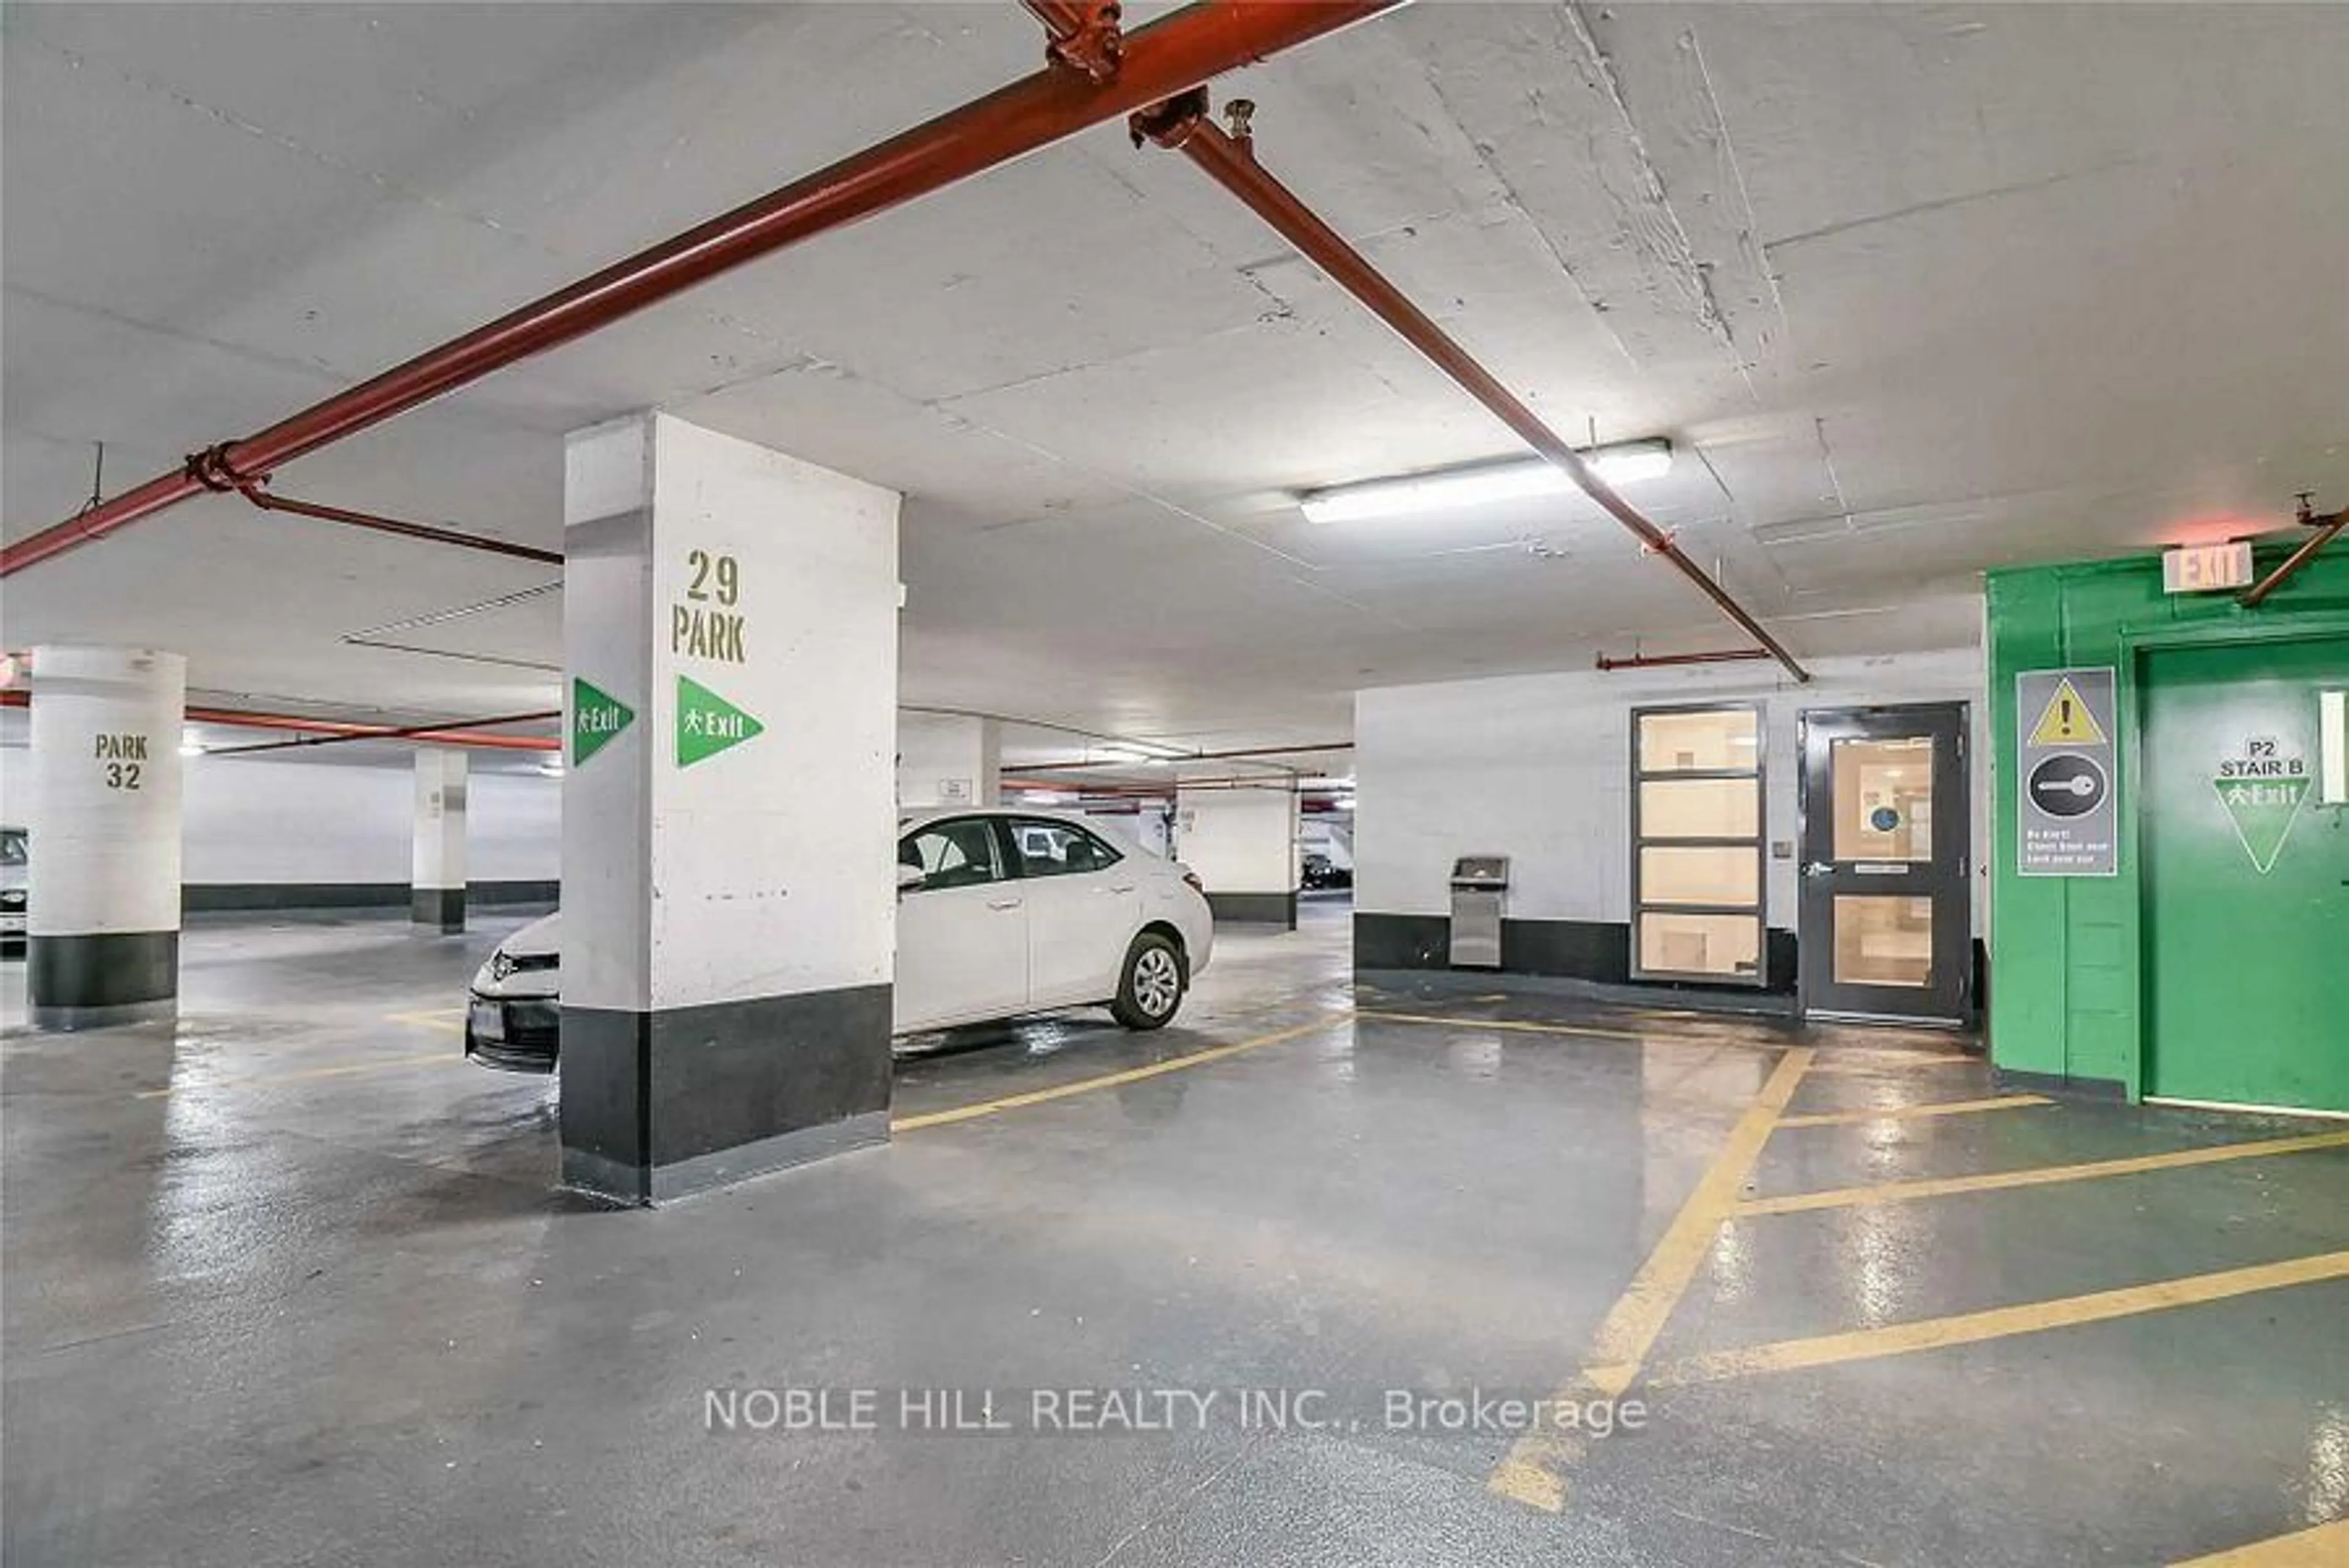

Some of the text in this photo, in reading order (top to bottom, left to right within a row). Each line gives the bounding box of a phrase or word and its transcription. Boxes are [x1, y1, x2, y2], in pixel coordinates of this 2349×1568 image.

[688, 549, 738, 606] 29
[2180, 548, 2238, 585] EXIT
[672, 604, 744, 663] PARK
[591, 705, 619, 732] Exit
[706, 712, 743, 738] Exit
[95, 734, 147, 760] PARK
[2249, 741, 2274, 756] P2
[106, 762, 140, 790] 32
[2221, 759, 2303, 776] STAIR B
[2252, 784, 2298, 805] Exit
